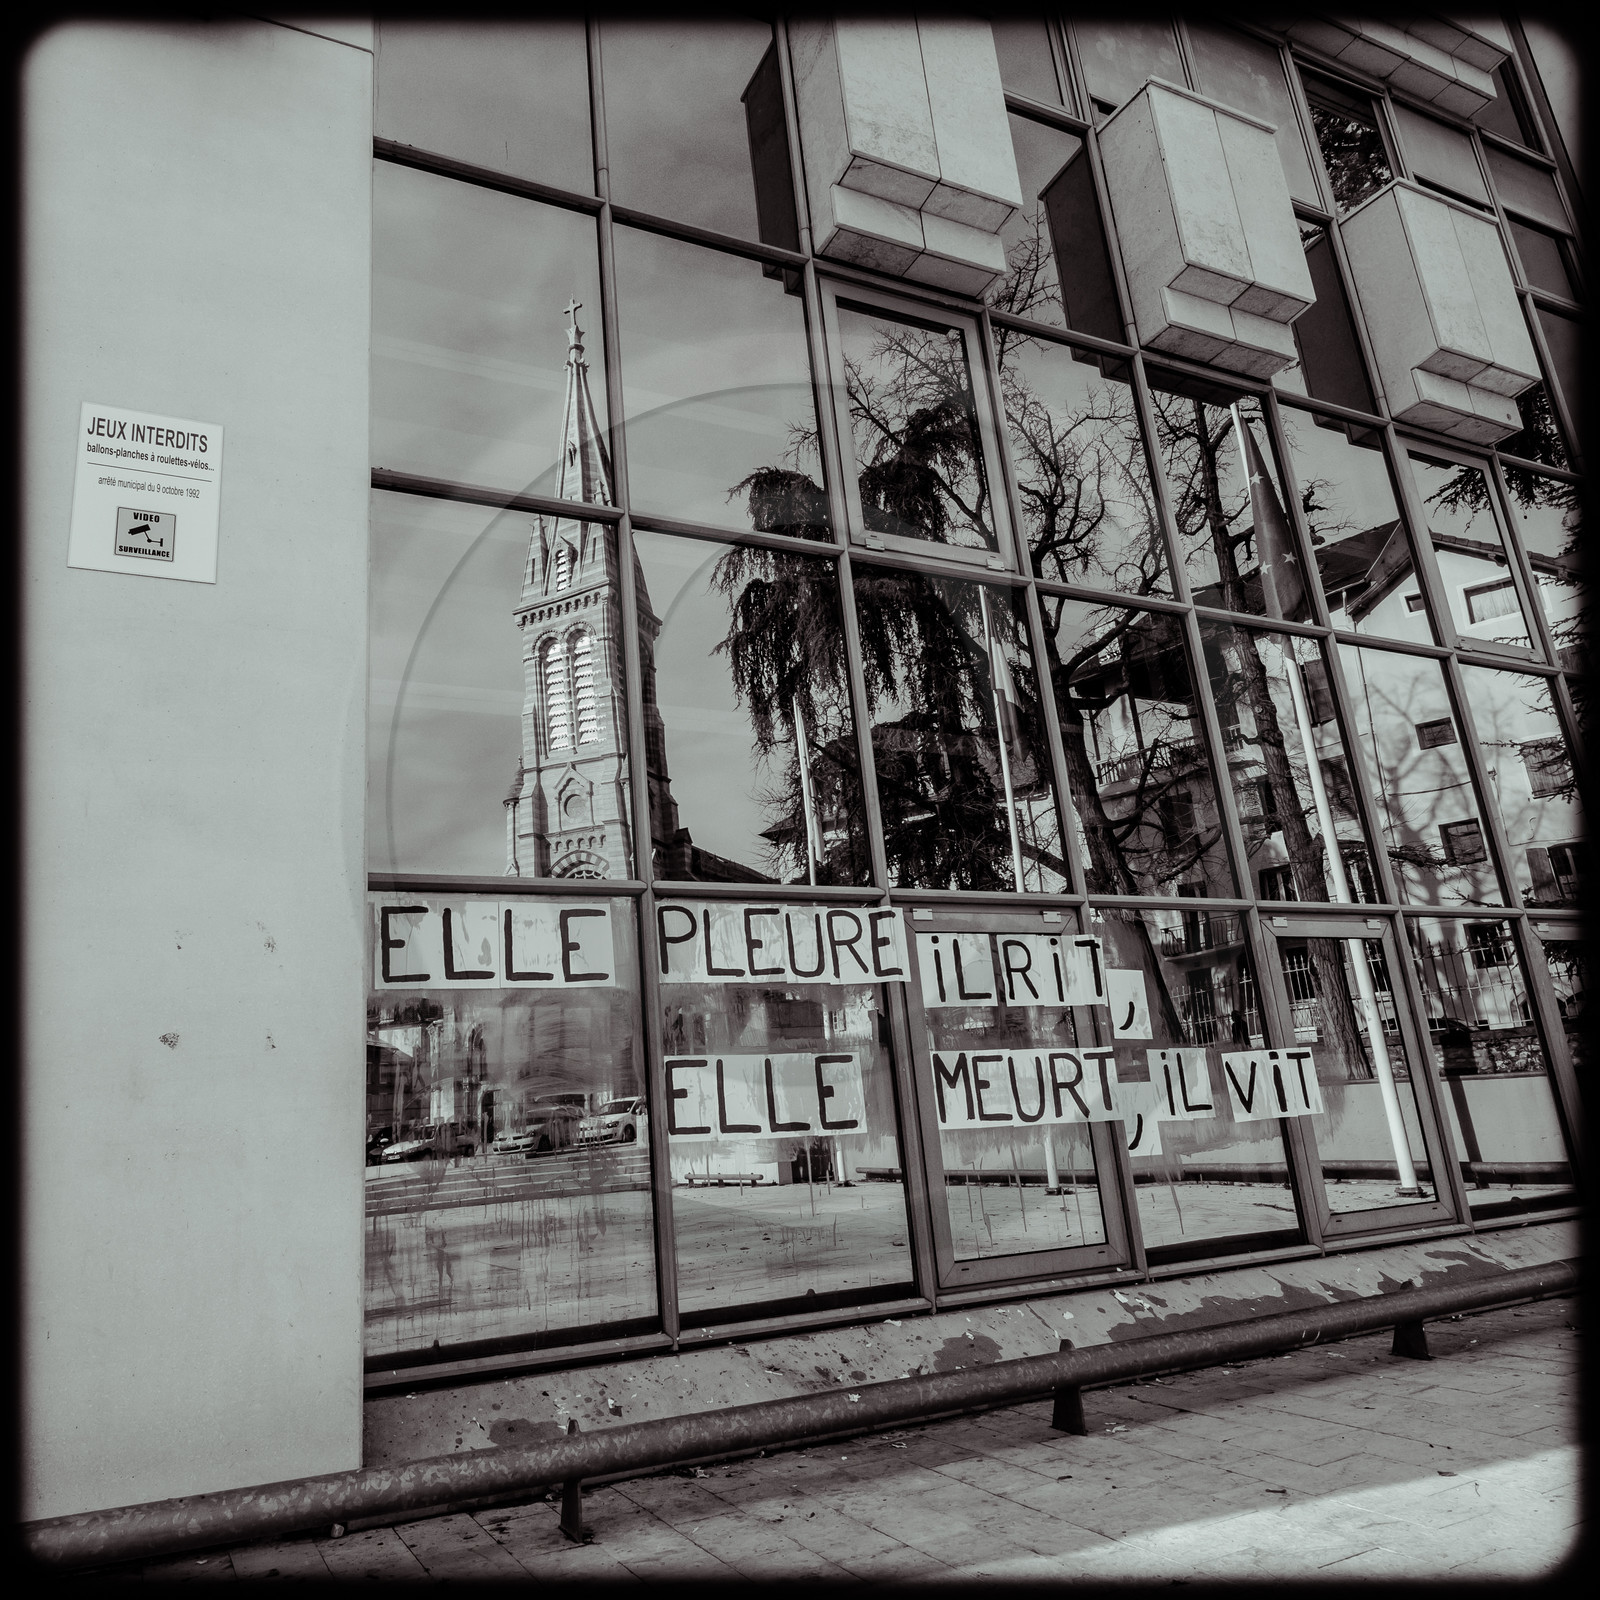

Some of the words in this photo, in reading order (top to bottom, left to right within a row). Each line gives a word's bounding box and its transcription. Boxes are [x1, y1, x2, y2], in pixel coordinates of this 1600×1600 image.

[87, 416, 127, 441] JEUX
[131, 423, 208, 453] INTERDITS
[86, 442, 149, 461] ballons-planches
[150, 451, 155, 462] à
[156, 454, 215, 471] roulettes-vélos...
[98, 476, 117, 487] arrêté
[117, 479, 147, 492] municipal
[147, 482, 156, 493] du
[156, 483, 161, 493] 9
[161, 485, 184, 497] octobre
[185, 488, 201, 499] 1992
[133, 512, 160, 523] VIDEO
[118, 545, 171, 558] SURVEILLANCE
[381, 905, 609, 983] ELLE
[658, 905, 904, 979] PLEURE
[665, 1055, 858, 1135] ELLE
